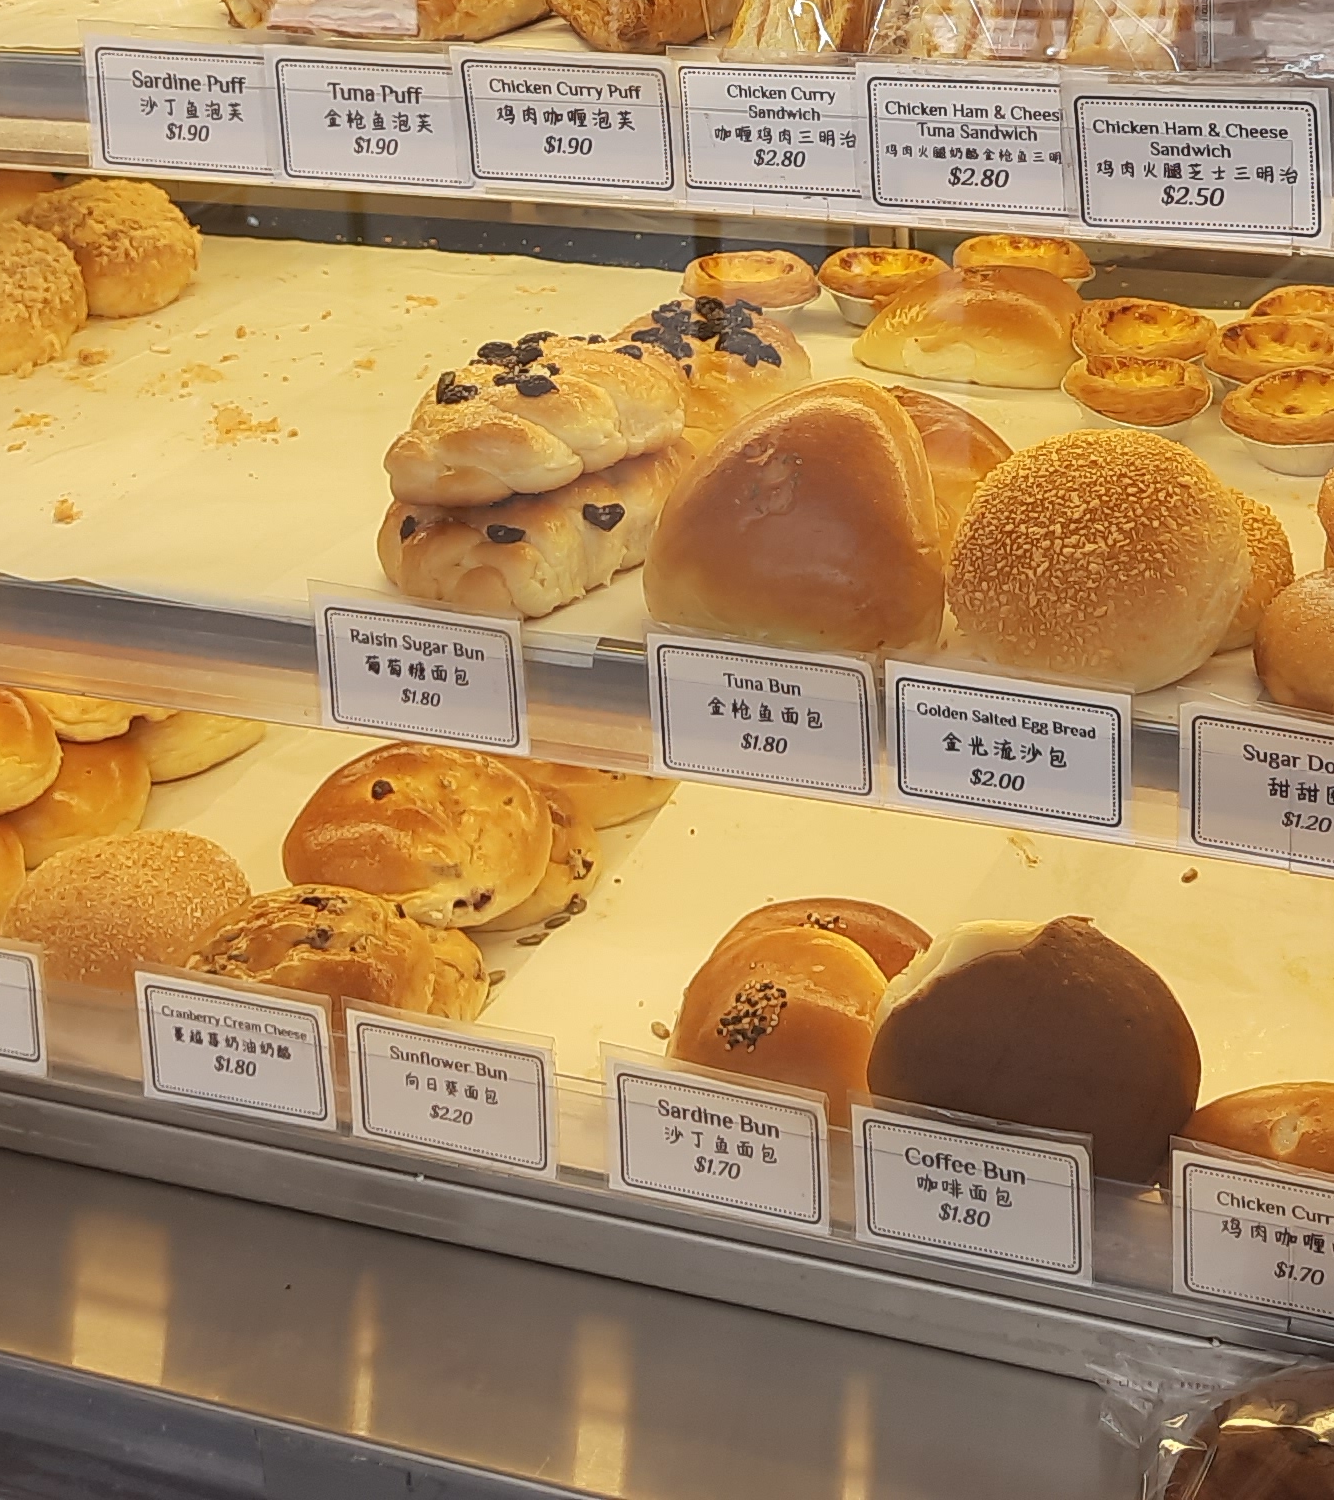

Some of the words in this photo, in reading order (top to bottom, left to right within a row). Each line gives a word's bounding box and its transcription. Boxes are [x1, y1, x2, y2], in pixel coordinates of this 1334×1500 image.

[132, 70, 201, 91] Sardine
[207, 75, 246, 93] Puff
[489, 79, 552, 94] Chicken
[557, 82, 602, 100] Curry
[607, 84, 642, 99] Puff
[327, 82, 375, 102] Tuna
[380, 85, 423, 104] Puff
[727, 84, 786, 100] Chicken
[791, 87, 835, 105] Curry
[749, 105, 820, 121] Sandwich
[885, 101, 947, 116] Chicken
[953, 104, 988, 119] Ham
[166, 123, 209, 142] $1.90
[917, 122, 954, 138] Tuna
[960, 125, 1038, 141] Sandwich
[1093, 120, 1159, 135] Chicken
[1166, 122, 1202, 137] Ham
[1226, 124, 1288, 139] Cheese
[354, 136, 398, 156] $1.90
[544, 136, 592, 155] $1.90
[1151, 142, 1231, 158] Sandwich
[754, 149, 805, 167] $2.80
[948, 167, 1009, 187] $2.80
[1161, 185, 1224, 207] $2.50
[350, 629, 397, 648] Raisin
[402, 635, 448, 655] Sugar
[454, 643, 485, 661] Bun
[723, 673, 763, 691] Tuna
[769, 679, 801, 696] Bun
[402, 688, 440, 707] $1.80
[708, 697, 822, 729] 金枪鱼面包
[917, 703, 967, 720] Golden
[972, 710, 1016, 727] Salted
[1022, 719, 1048, 735] Egg
[1053, 721, 1096, 739] Bread
[741, 733, 787, 754] $1.80
[942, 732, 1066, 768] 金光流沙包
[1243, 744, 1300, 769] Sugar
[970, 769, 1025, 791] $2.00
[1282, 812, 1332, 833] $1.20
[224, 1017, 261, 1032] Cream
[214, 1055, 256, 1077] $1.80
[390, 1046, 471, 1073] Sunflower
[475, 1062, 507, 1081] Bun
[430, 1105, 472, 1125] $2.20
[658, 1099, 734, 1129] Sardine
[740, 1114, 780, 1138] Bun
[665, 1126, 777, 1164] 沙丁鱼面包
[694, 1156, 741, 1179] $1.70
[905, 1147, 976, 1175] Coffee
[983, 1160, 1026, 1185] Bun
[917, 1174, 1012, 1207] 咖啡面包
[1217, 1191, 1286, 1217] Chicken
[939, 1204, 990, 1227] $1.80
[1275, 1262, 1325, 1285] $1.70
